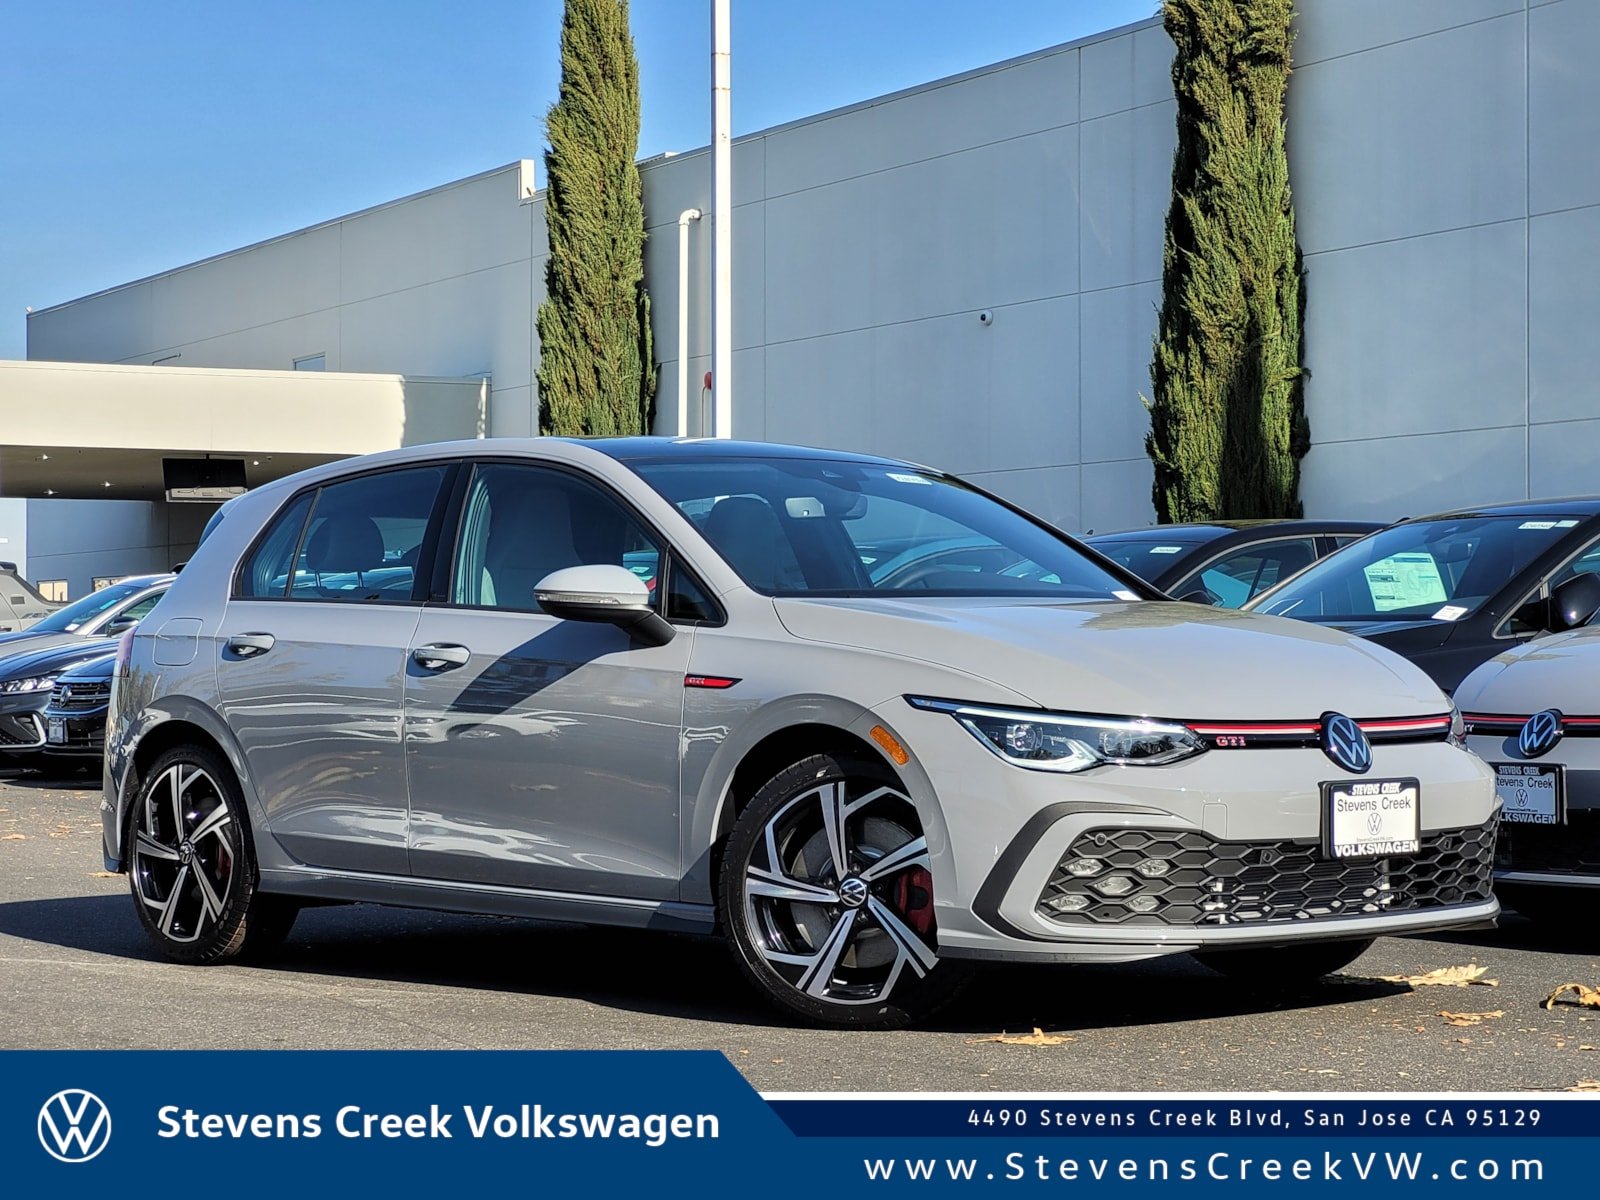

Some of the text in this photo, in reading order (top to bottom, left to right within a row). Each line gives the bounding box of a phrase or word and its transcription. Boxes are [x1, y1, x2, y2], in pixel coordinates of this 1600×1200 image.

[1215, 735, 1246, 747] GTI
[1499, 766, 1540, 775] STEVENS CREEK
[1352, 782, 1401, 796] STEVENS CREEK
[1496, 777, 1553, 789] tevens Creek
[1337, 796, 1411, 812] Stevens Creek
[1500, 813, 1556, 823] LKSWAGEN
[1334, 841, 1419, 857] VOLKSWAGEN
